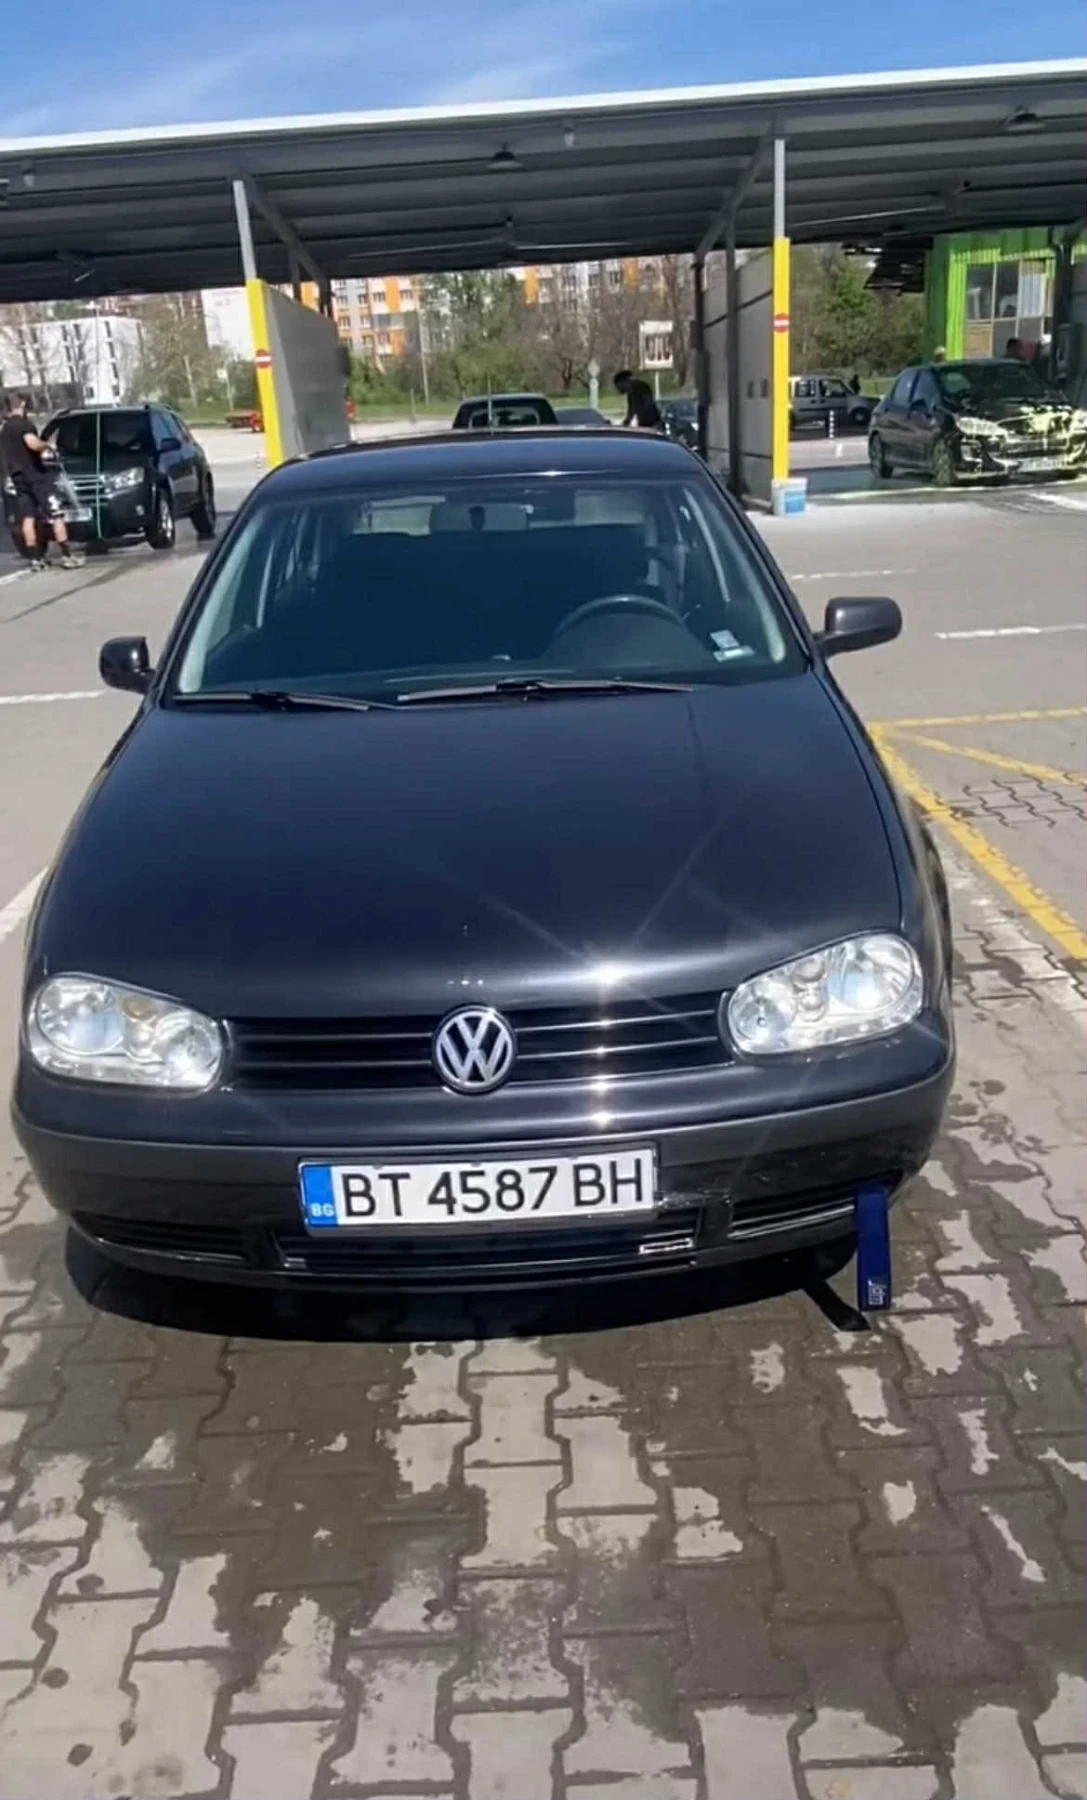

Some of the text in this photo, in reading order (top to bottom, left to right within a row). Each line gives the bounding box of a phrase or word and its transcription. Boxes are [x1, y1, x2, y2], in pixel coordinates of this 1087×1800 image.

[341, 1158, 643, 1217] BT 4587 BH
[311, 1204, 335, 1217] BG
